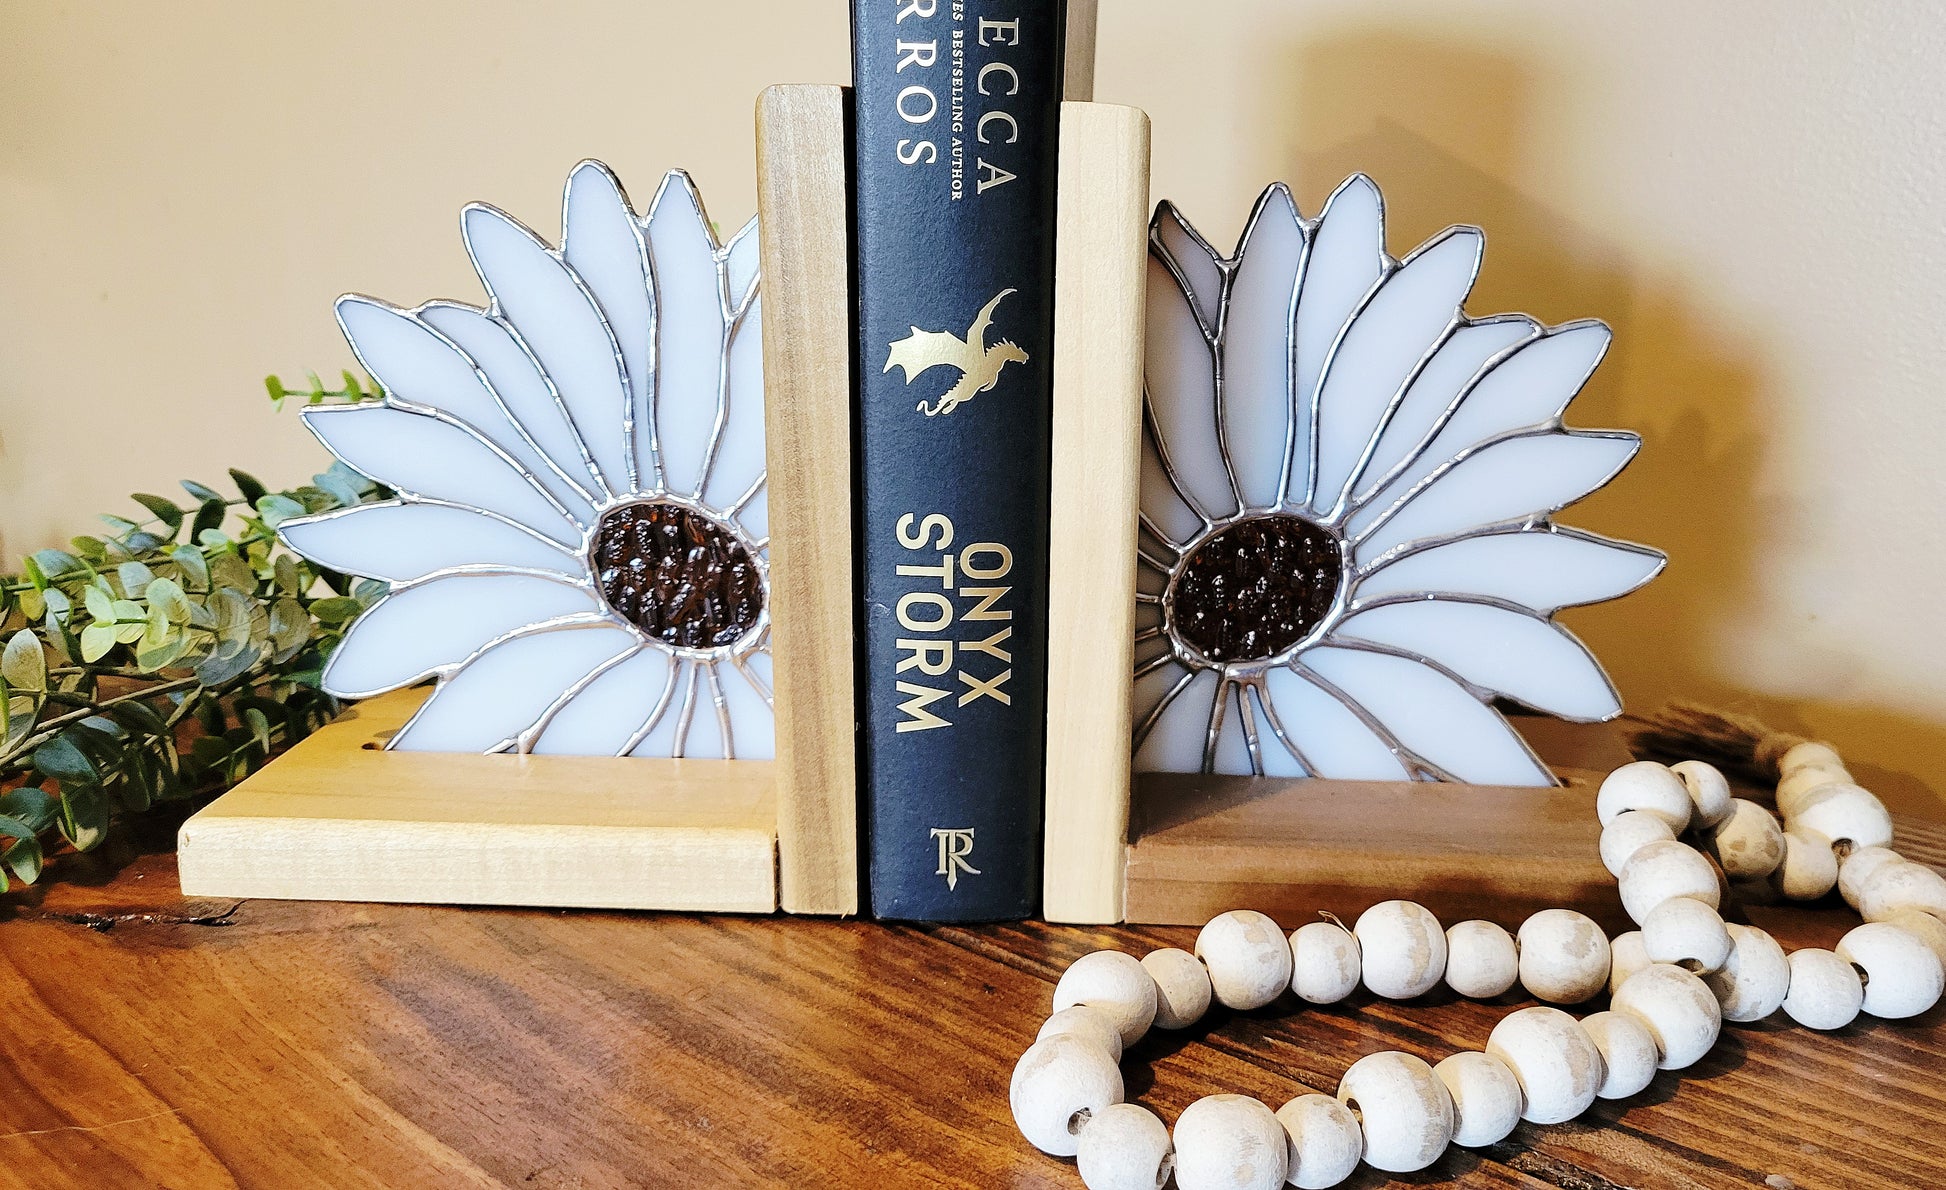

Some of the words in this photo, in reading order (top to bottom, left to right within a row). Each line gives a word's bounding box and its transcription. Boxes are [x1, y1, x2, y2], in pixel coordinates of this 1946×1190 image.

[896, 0, 937, 165] RROS
[951, 30, 964, 132] BESTSELLING
[952, 0, 964, 21] ES
[951, 137, 963, 201] AUTHOR
[977, 16, 1020, 195] ECCA
[896, 512, 954, 733] STORM
[958, 542, 1013, 708] ONYX
